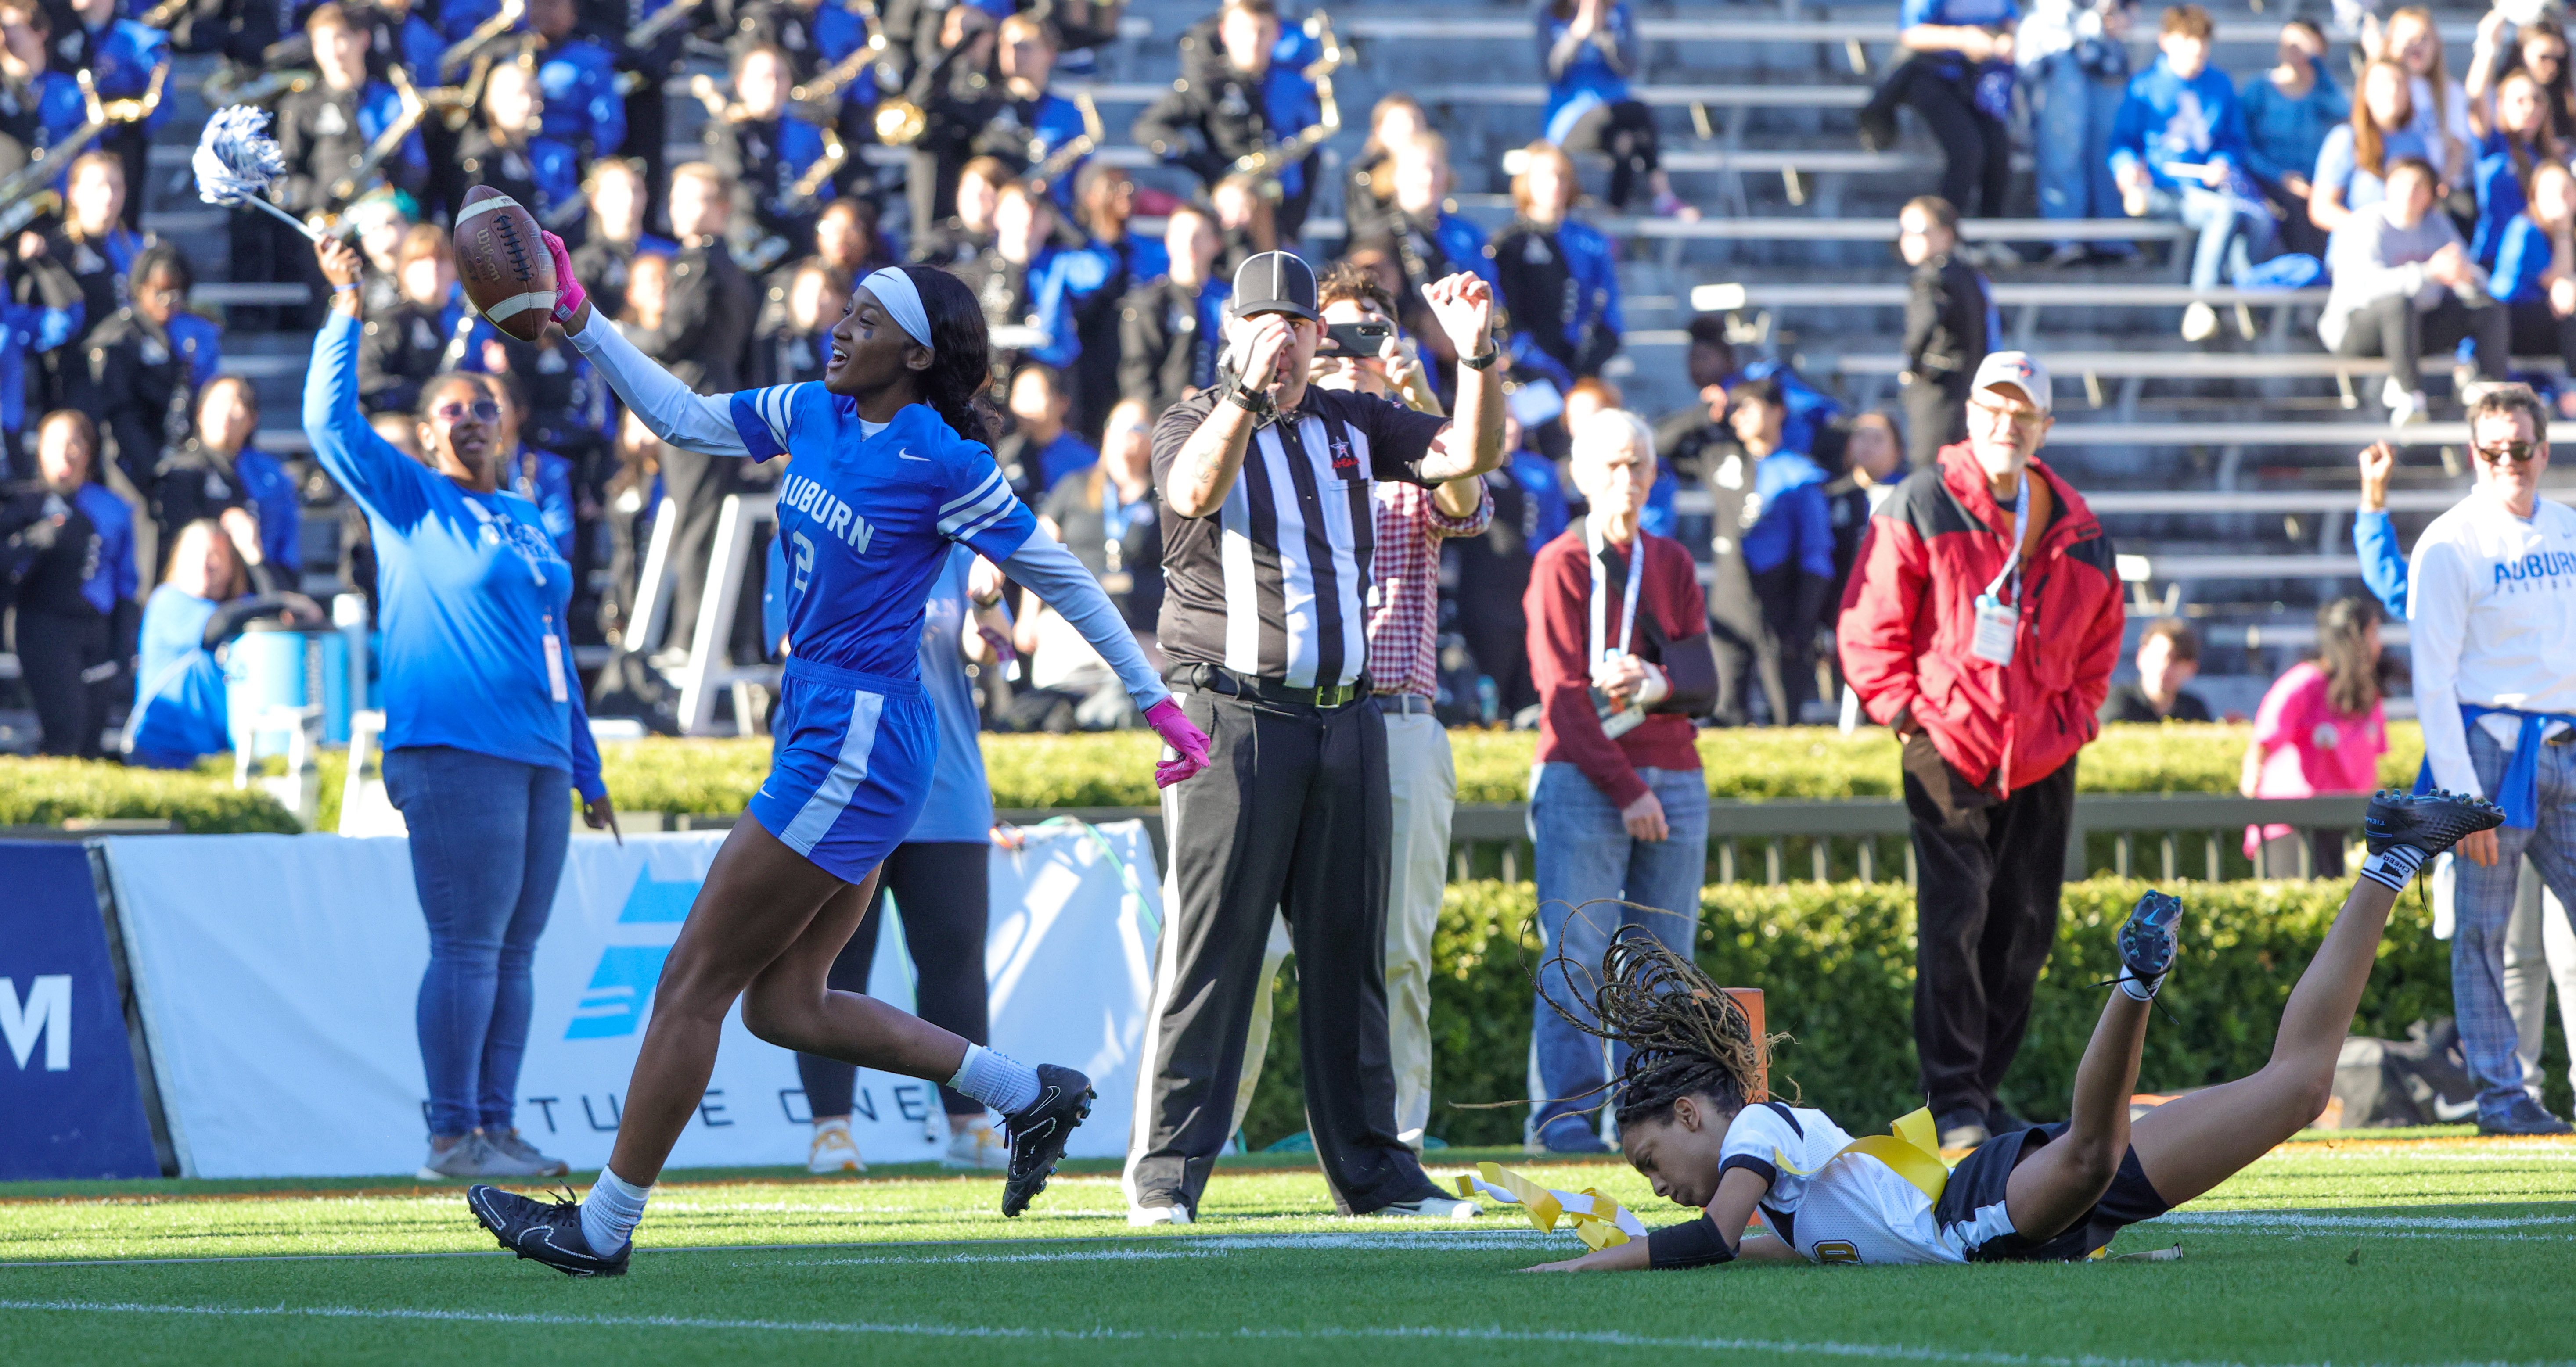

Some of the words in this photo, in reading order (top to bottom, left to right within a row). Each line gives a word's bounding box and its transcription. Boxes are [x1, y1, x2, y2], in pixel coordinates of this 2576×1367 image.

[476, 227, 501, 281] Wilson
[777, 473, 874, 555] AUBURN
[793, 530, 815, 598] 2
[2383, 854, 2410, 874] CHEER
